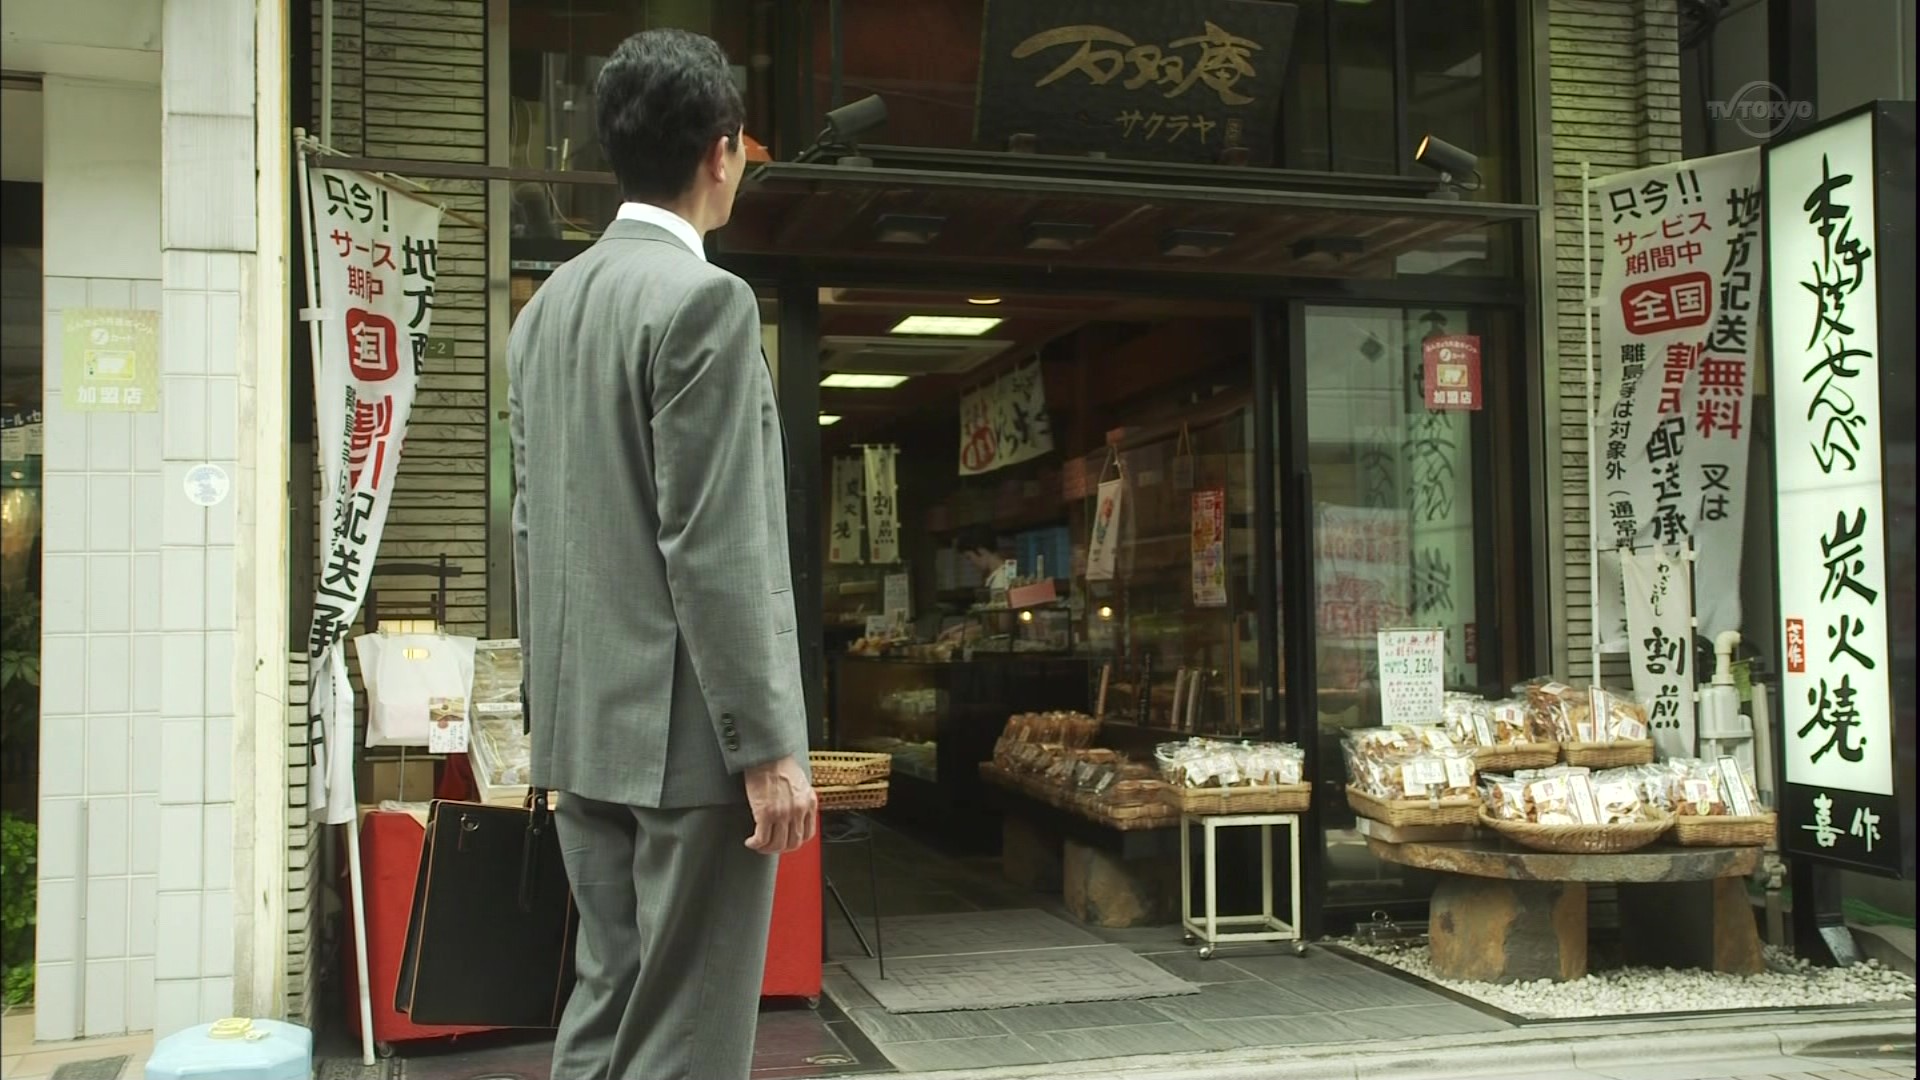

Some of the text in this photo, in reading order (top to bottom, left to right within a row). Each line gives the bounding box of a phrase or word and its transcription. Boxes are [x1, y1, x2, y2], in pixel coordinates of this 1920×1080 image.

[1115, 110, 1217, 144] サクラヤ
[329, 228, 397, 271] サース
[1613, 211, 1713, 255] サービス
[1624, 239, 1703, 277] 期間中
[1628, 280, 1707, 328] 全国
[76, 385, 144, 405] 加盟店
[1433, 390, 1472, 405] 加盟店
[1801, 792, 1882, 853] 喜作
